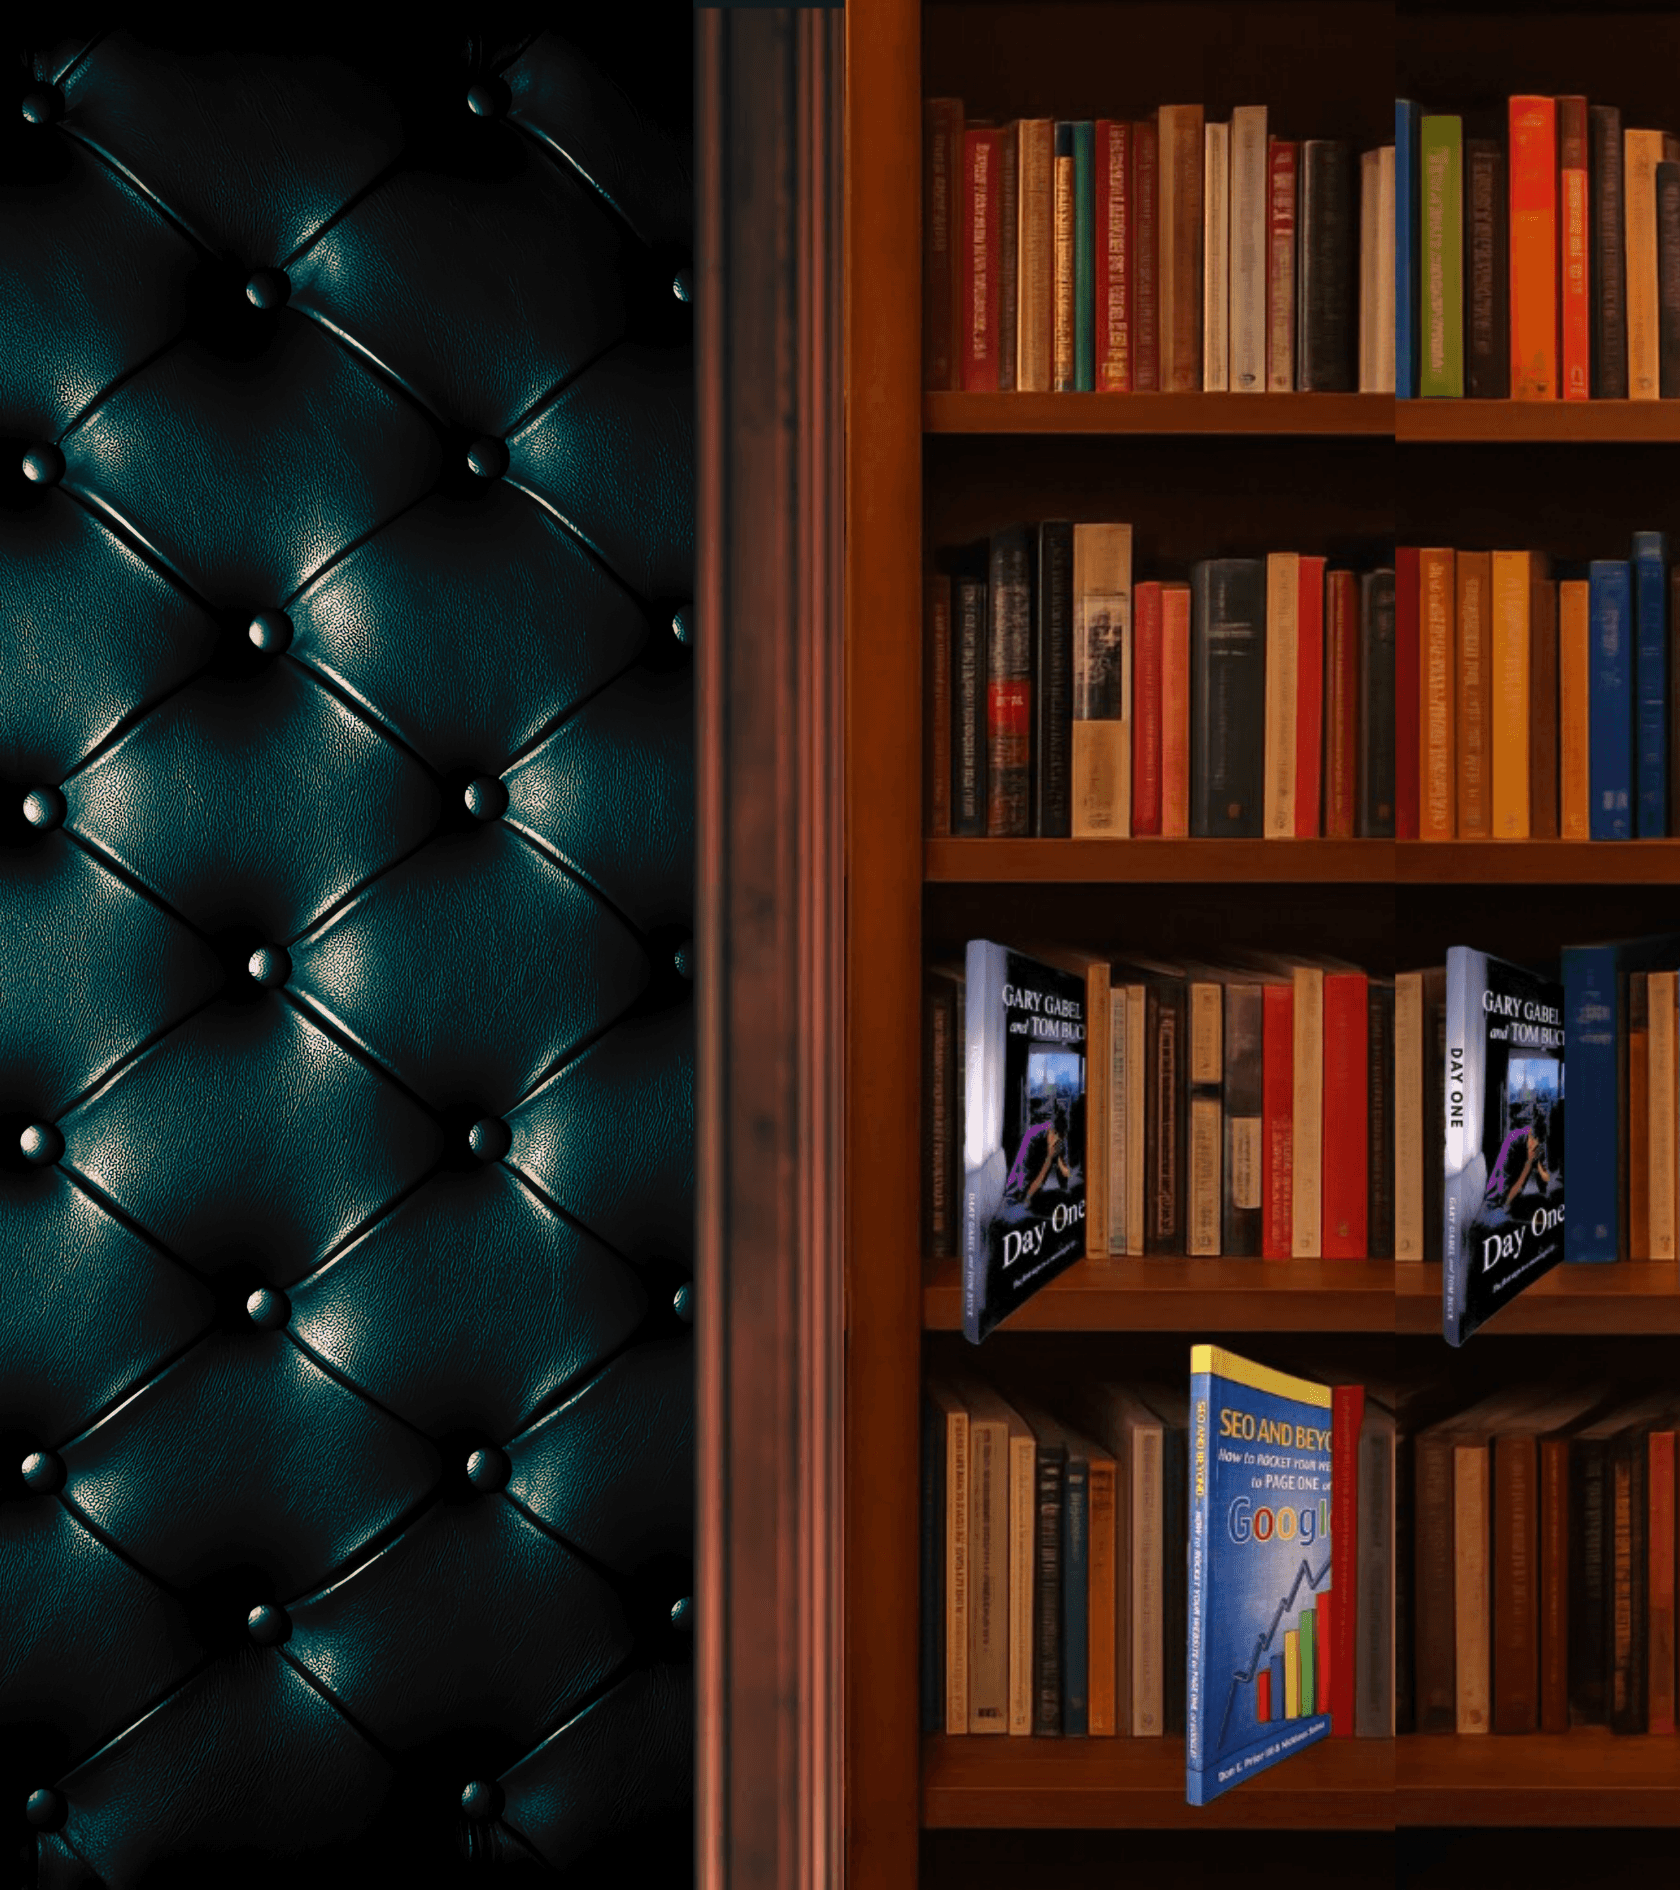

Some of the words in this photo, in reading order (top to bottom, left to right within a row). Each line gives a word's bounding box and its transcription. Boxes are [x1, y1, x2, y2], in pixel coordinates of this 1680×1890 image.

[1002, 984, 1042, 1012] GARY
[1044, 995, 1082, 1020] GABEL
[1482, 990, 1522, 1018] GARY
[1524, 1001, 1561, 1026] GABEL
[1009, 1018, 1029, 1035] and
[1031, 1016, 1060, 1038] TOM
[1490, 1025, 1509, 1040] and
[1511, 1022, 1539, 1042] TOM
[1451, 1048, 1463, 1083] DAY
[1451, 1091, 1463, 1128] ONE
[1002, 1220, 1046, 1269] Day
[1052, 1200, 1085, 1233] One
[1482, 1225, 1526, 1273] Day
[1531, 1204, 1565, 1236] One
[1220, 1408, 1255, 1440] SEO
[1257, 1418, 1293, 1447] AND
[1243, 1452, 1255, 1465] to
[1257, 1454, 1292, 1469] ROCKET
[1251, 1478, 1262, 1489] to
[1265, 1474, 1295, 1490] PAGE
[1298, 1476, 1319, 1491] ONE
